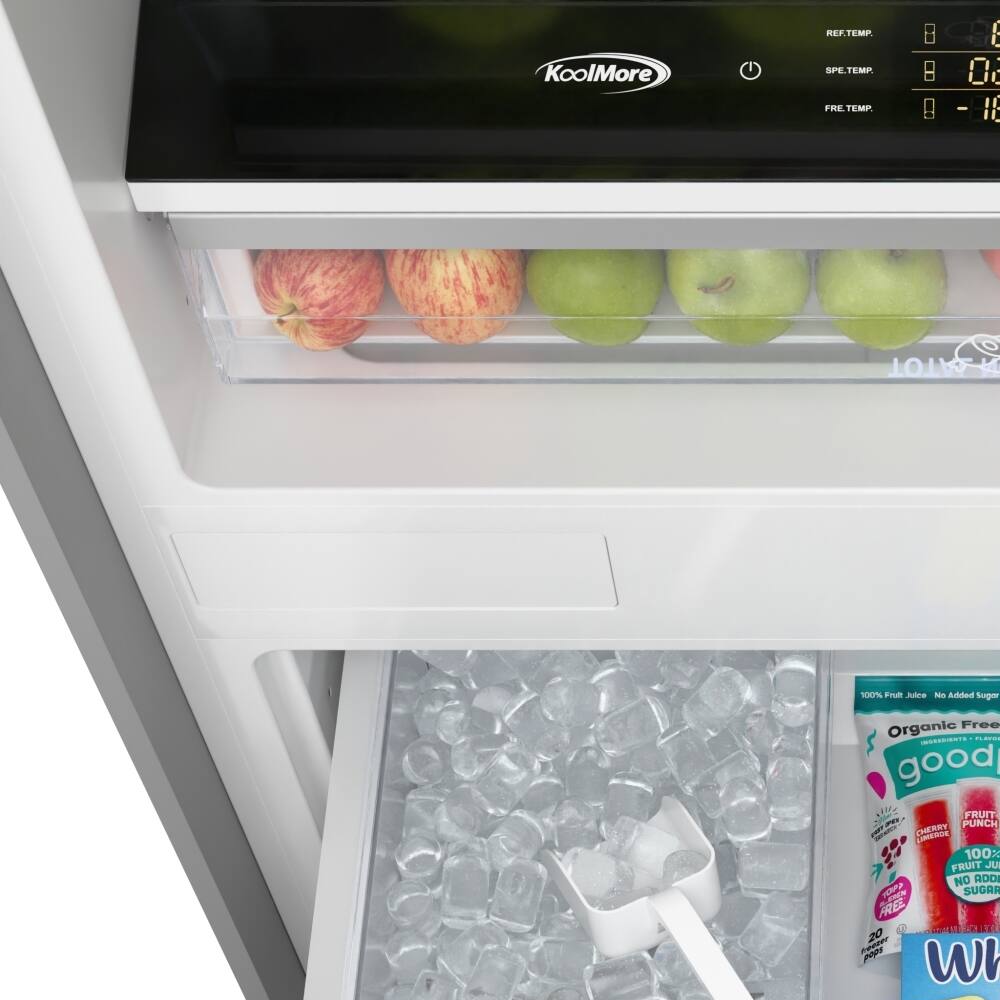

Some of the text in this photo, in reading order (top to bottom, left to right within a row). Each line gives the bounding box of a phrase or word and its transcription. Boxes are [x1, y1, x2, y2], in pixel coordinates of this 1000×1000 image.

[826, 29, 873, 37] REF.TEMP.
[544, 63, 653, 82] KoolMore
[825, 66, 873, 75] SPE.TEMP.
[976, 692, 999, 701] Sugar
[888, 720, 957, 739] Organic
[964, 810, 996, 820] FRUIT
[915, 823, 949, 837] CHERRY
[962, 818, 998, 829] PUNCH
[915, 830, 950, 844] LIMEADE
[964, 848, 1000, 859] 100%
[951, 861, 981, 873] FRUIT
[954, 876, 970, 887] NO
[879, 898, 906, 919] FREE
[868, 927, 883, 943] 20
[861, 936, 889, 955] freezer
[863, 946, 884, 964] pops
